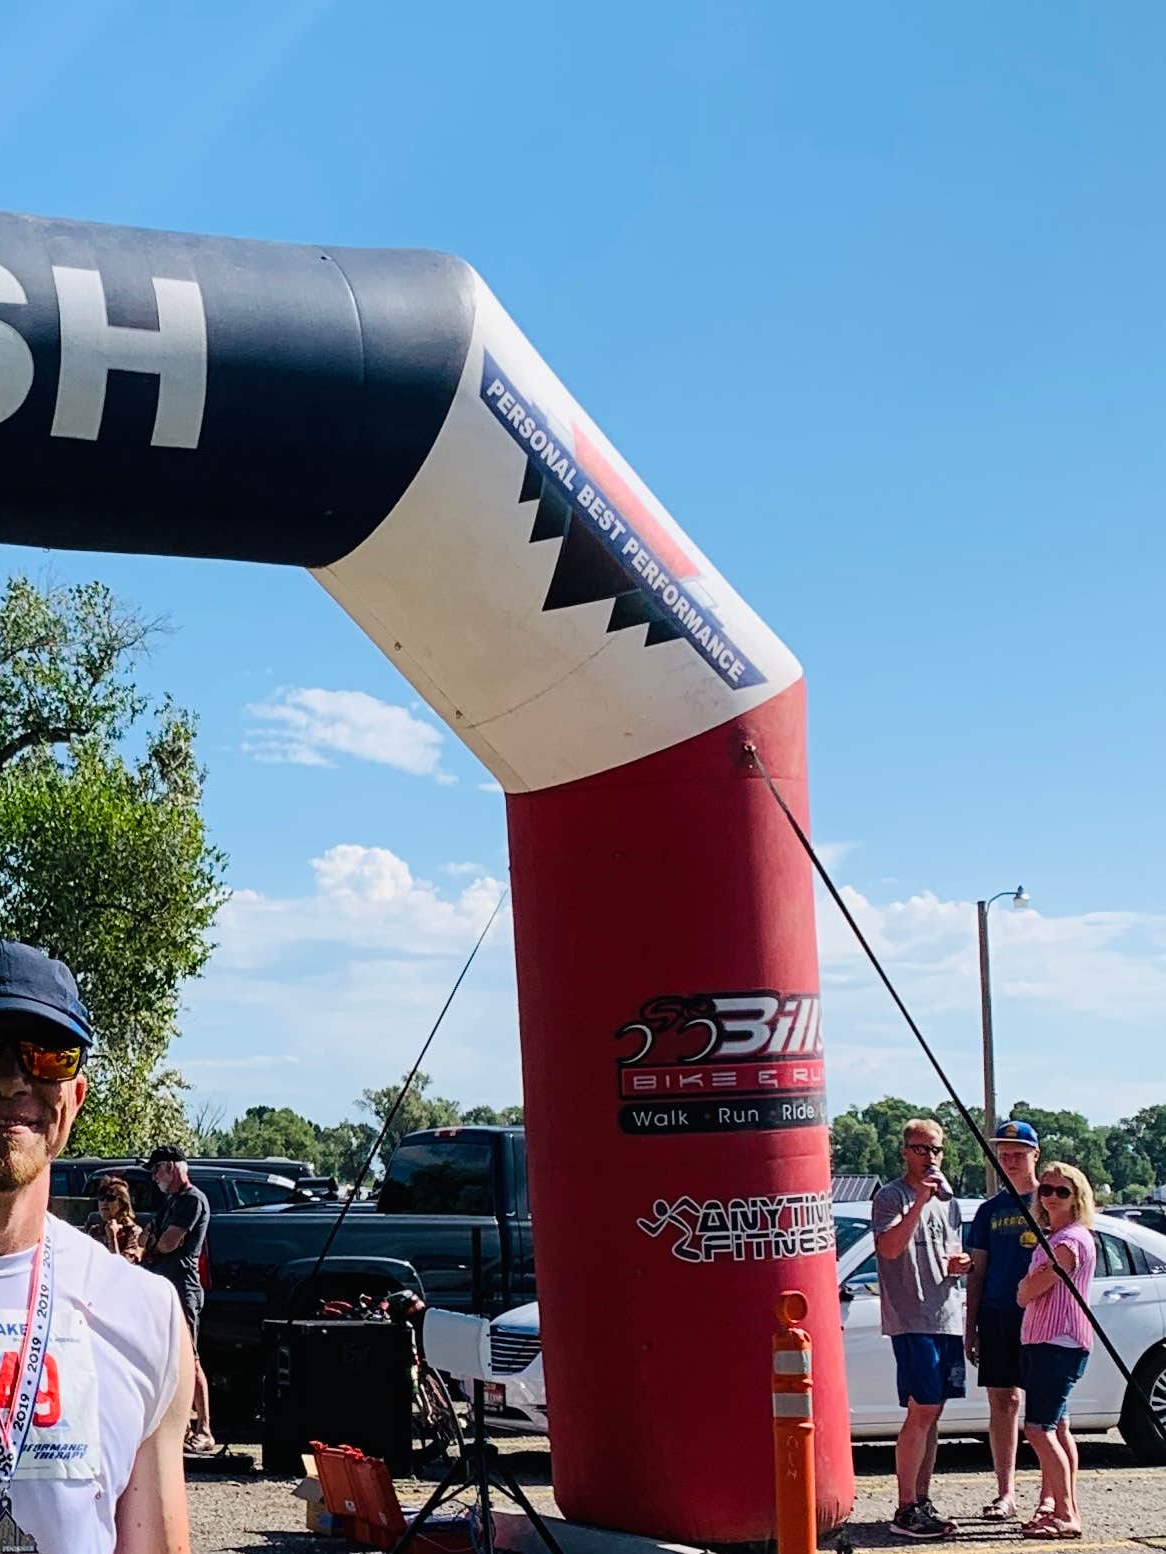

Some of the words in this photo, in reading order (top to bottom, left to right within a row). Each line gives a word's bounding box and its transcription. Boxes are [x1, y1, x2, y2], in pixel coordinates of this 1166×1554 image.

[486, 378, 577, 491] PERSONAL
[576, 484, 626, 541] BEST
[622, 537, 747, 684] PERFORMANCE
[633, 1072, 737, 1090] BIKE
[793, 1068, 823, 1083] RU
[632, 1110, 689, 1127] Walk
[718, 1108, 759, 1124] Run
[782, 1103, 815, 1120] Ride
[37, 1284, 50, 1318] 2019
[27, 1337, 42, 1373] 2019
[13, 1393, 30, 1431] 2019
